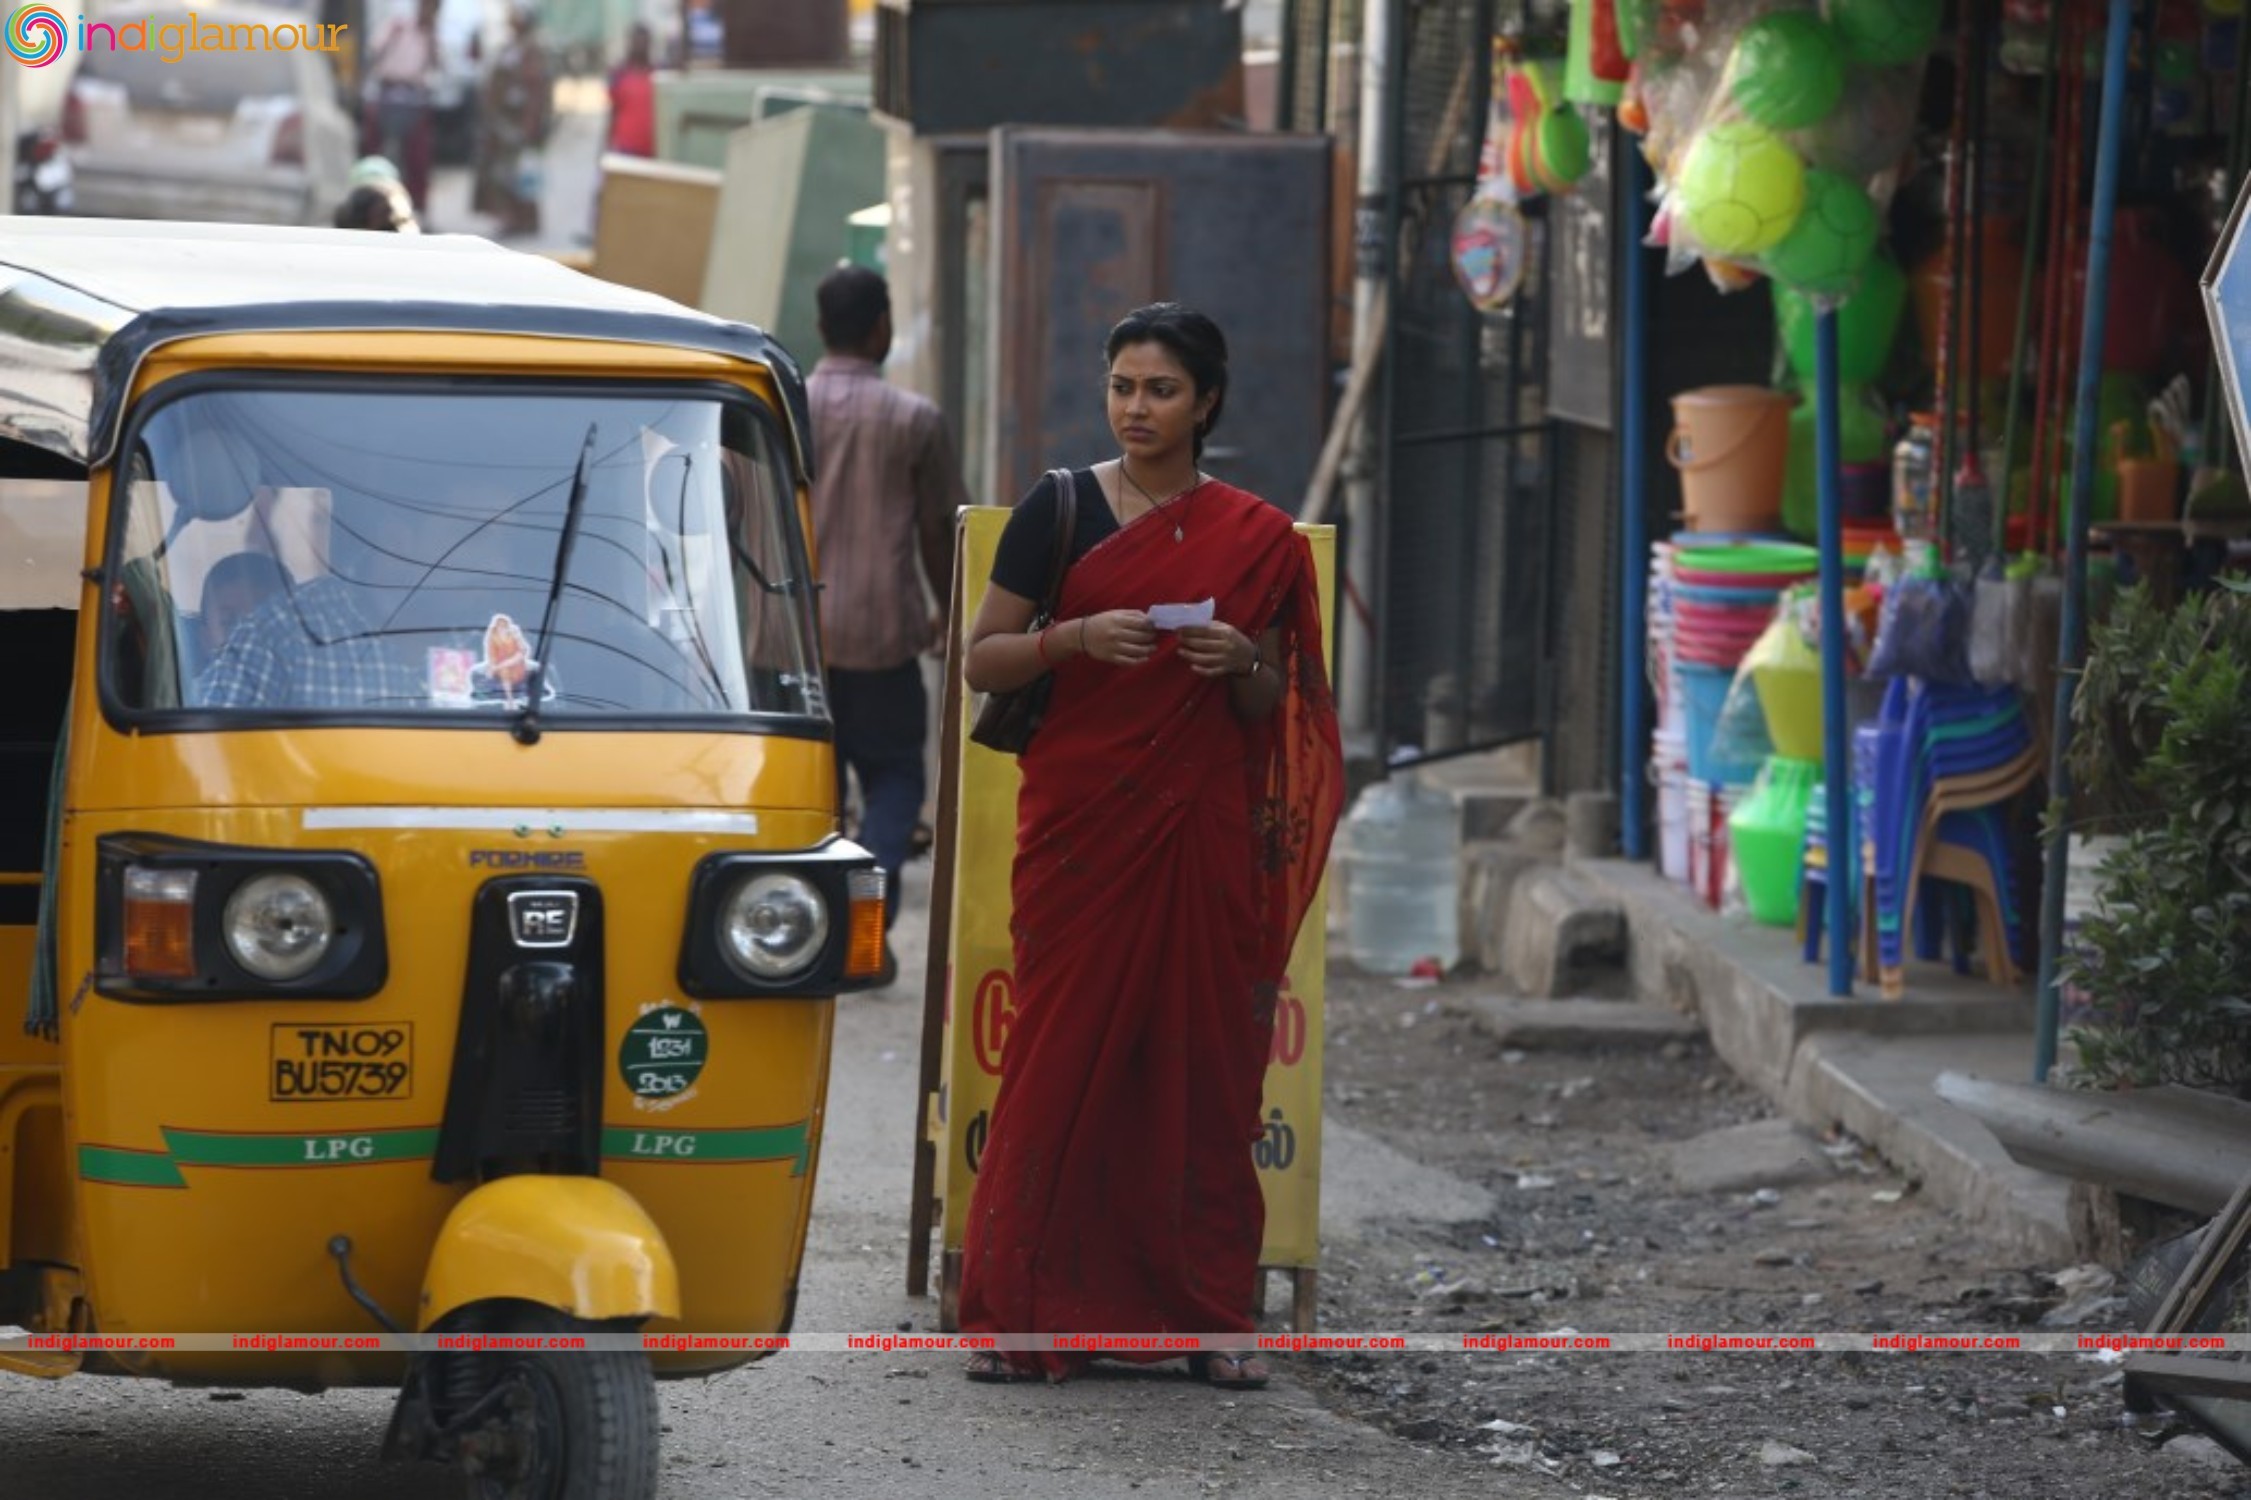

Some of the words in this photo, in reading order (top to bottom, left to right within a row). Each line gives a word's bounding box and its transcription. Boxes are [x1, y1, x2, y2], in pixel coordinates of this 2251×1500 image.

[522, 910, 566, 935] RE
[275, 1059, 408, 1096] BU5739
[304, 1137, 374, 1160] LPG
[632, 1134, 696, 1156] LPG
